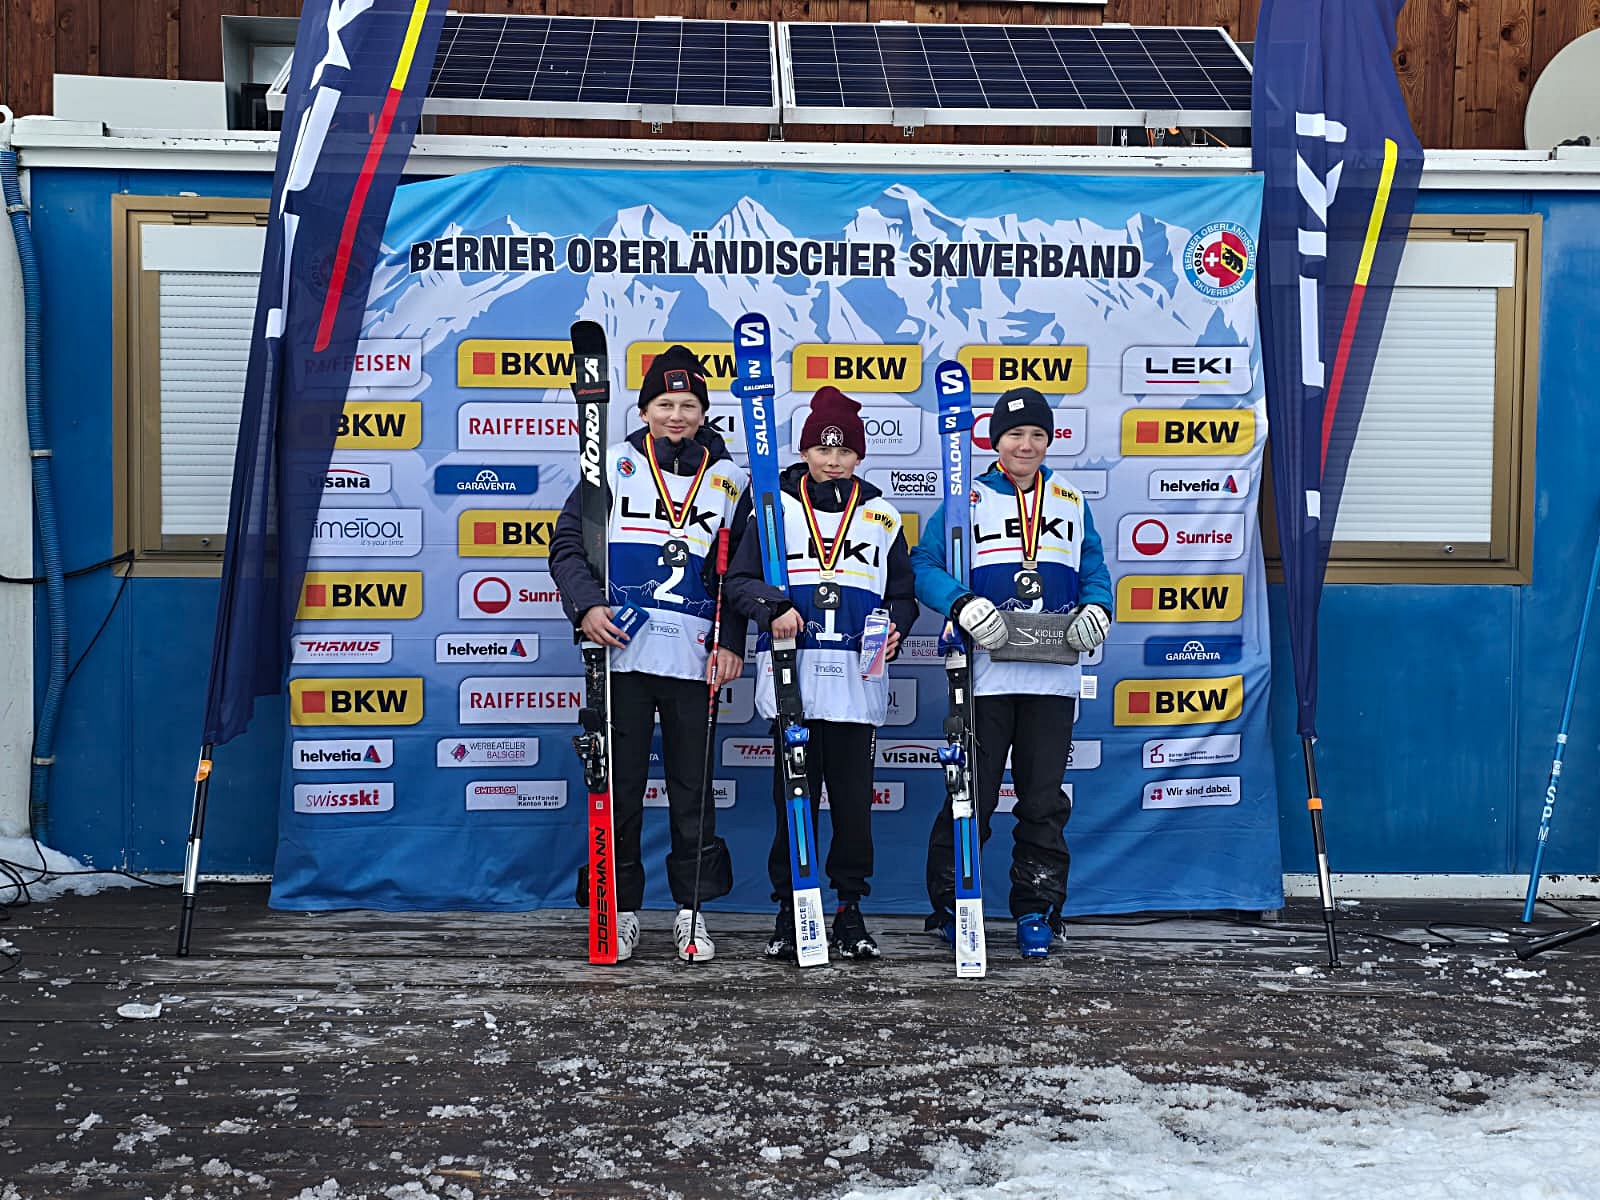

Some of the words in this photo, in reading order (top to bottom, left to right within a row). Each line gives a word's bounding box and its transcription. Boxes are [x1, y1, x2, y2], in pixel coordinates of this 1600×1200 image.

[409, 236, 555, 274] BERNER
[567, 232, 895, 277] OBERLÄNDISCHER
[909, 244, 1141, 279] SKIVERBAND
[1184, 234, 1202, 270] BERNER
[1200, 223, 1256, 271] OBERLÄNDISCHER
[1194, 244, 1205, 275] BOSV
[1193, 279, 1246, 297] SKIVERBAND
[501, 352, 576, 376] BKW
[699, 353, 738, 380] KW
[834, 356, 907, 380] BKW
[999, 357, 1073, 381] BKW
[1146, 357, 1231, 374] LEKI
[743, 383, 774, 392] SALOMON
[748, 359, 770, 456] SALOMN
[334, 413, 406, 437] BKW
[469, 418, 580, 436] RAIFFEISEN
[581, 357, 602, 488] NORDA
[704, 416, 735, 433] KI
[1165, 421, 1239, 443] BKW
[948, 406, 963, 496] SALOM
[891, 471, 925, 482] Massa
[1160, 479, 1220, 492] helvetia
[457, 481, 516, 491] GARAVENTA
[892, 482, 936, 493] Vecchia
[621, 496, 727, 535] LEK
[974, 516, 1074, 544] LEKI
[1176, 530, 1233, 544] Sunrise
[332, 584, 407, 607] BKW
[518, 588, 561, 603] Sunri
[1158, 586, 1229, 610] BKW
[447, 639, 508, 656] helvetia
[1040, 637, 1064, 646] Lenk
[1165, 652, 1221, 661] GARAVENTA
[331, 689, 408, 713] BKW
[470, 691, 581, 709] RAIFFEISEN
[1155, 688, 1229, 714] BKW
[300, 748, 361, 762] helvetia
[469, 742, 526, 750] WERBEATELIER
[487, 750, 525, 759] BALSIGER
[475, 786, 516, 795] SWISSLOS
[1166, 787, 1183, 797] Wir
[1185, 786, 1203, 796] sind
[1205, 784, 1232, 795] dabei.
